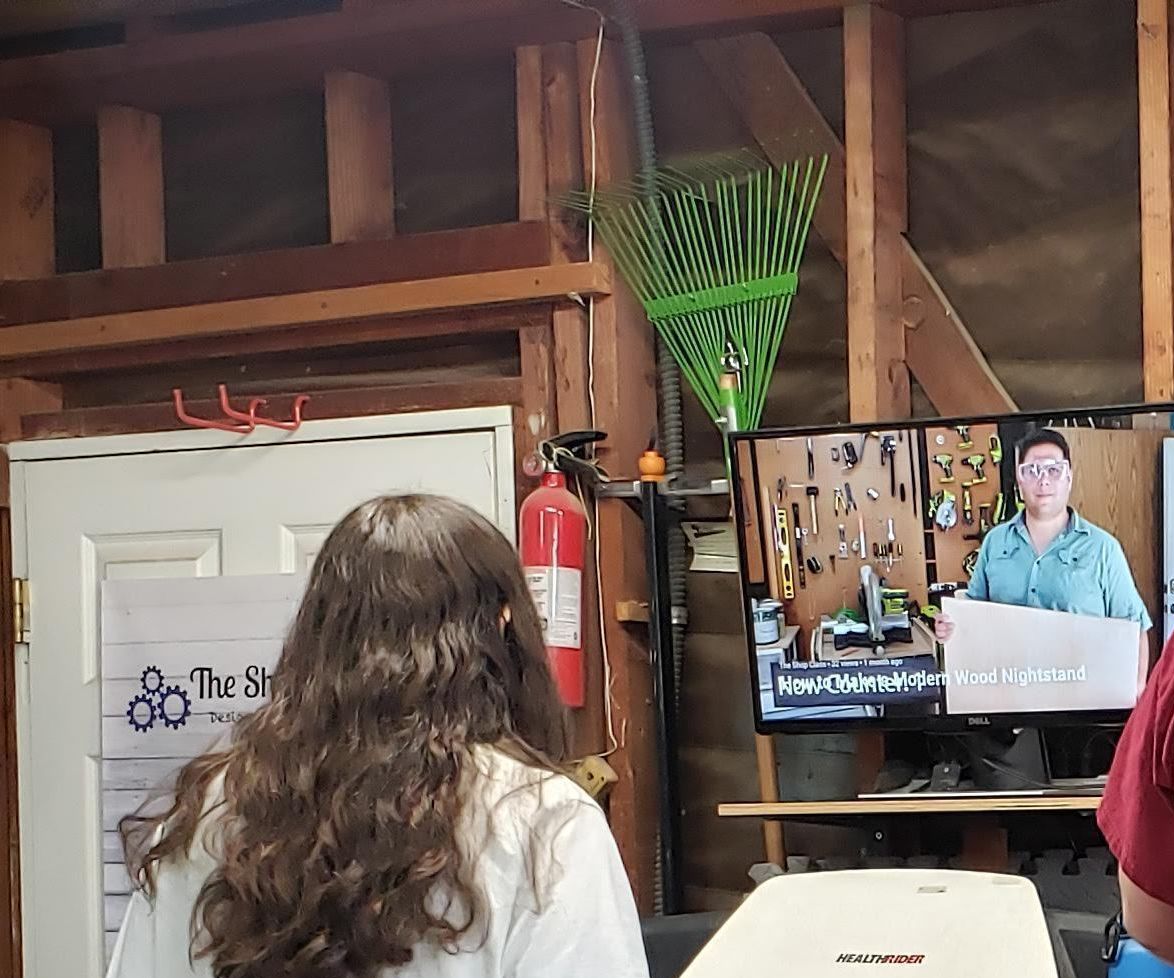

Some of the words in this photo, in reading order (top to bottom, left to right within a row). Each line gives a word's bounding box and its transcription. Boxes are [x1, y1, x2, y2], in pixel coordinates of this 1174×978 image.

[190, 667, 236, 699] The
[955, 668, 997, 686] Wood
[1001, 665, 1087, 686] Nightstand
[836, 953, 925, 964] HEALTHRIDER
